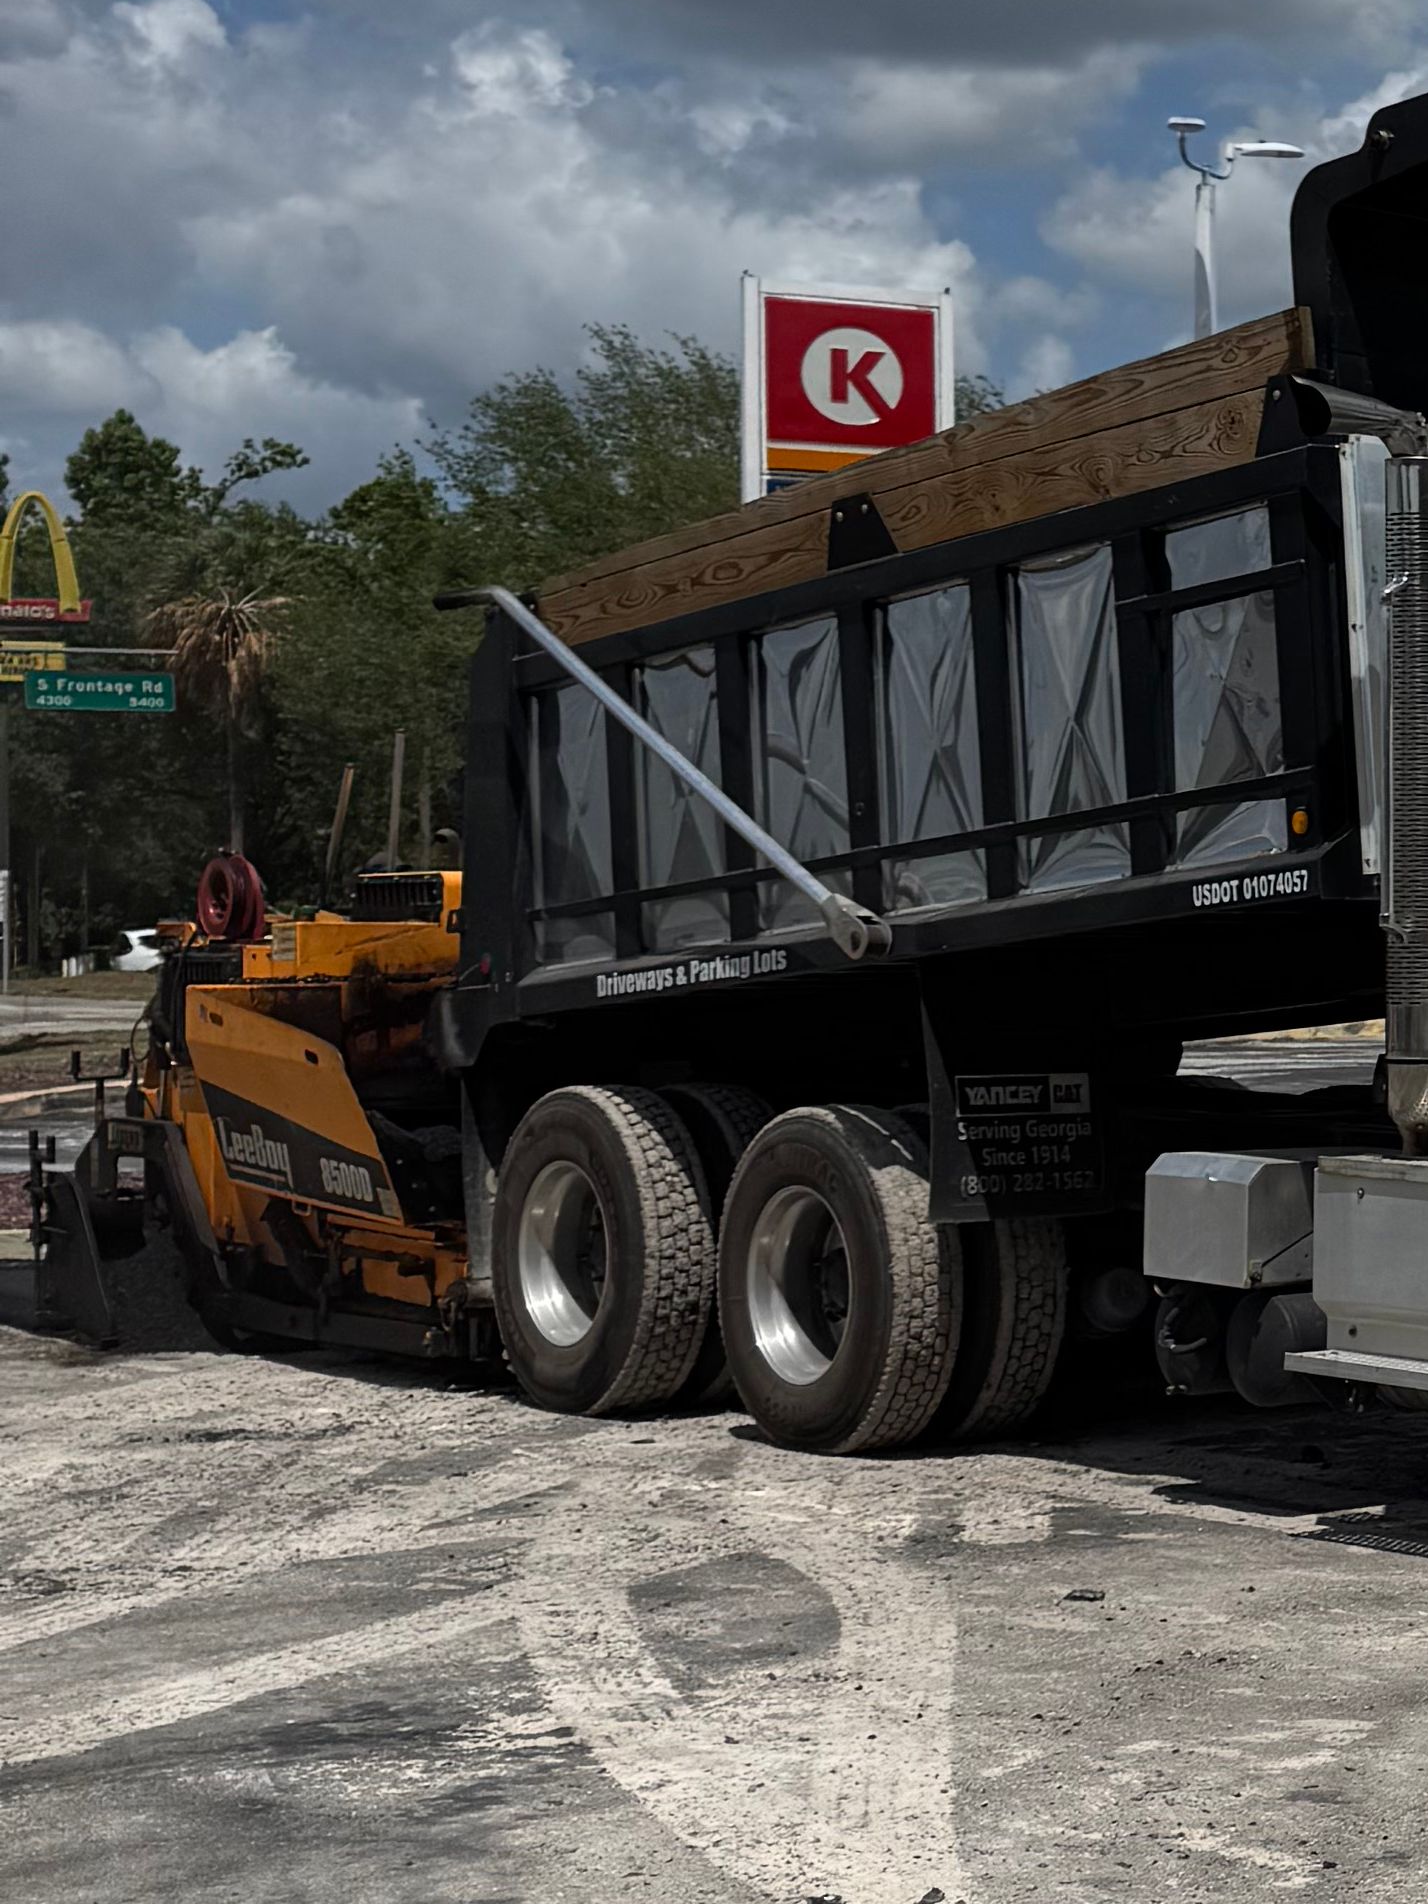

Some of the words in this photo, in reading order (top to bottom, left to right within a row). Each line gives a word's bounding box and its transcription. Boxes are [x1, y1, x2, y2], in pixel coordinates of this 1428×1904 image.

[37, 678, 48, 692] S
[56, 678, 133, 695] Frontage
[142, 680, 164, 693] Rd
[1192, 879, 1240, 907] USDOT
[1243, 869, 1308, 900] 01074057
[596, 966, 673, 998] Driveways
[676, 965, 687, 986] &
[690, 954, 750, 984] Parking
[753, 948, 787, 975] Lots
[965, 1084, 1043, 1106] YANCEY
[957, 1120, 1021, 1144] Serving
[1025, 1117, 1092, 1142] Georgia
[217, 1115, 295, 1189] LeeBoy
[981, 1148, 1026, 1166] Since
[1031, 1145, 1072, 1164] 1914
[960, 1174, 1007, 1197] (800)
